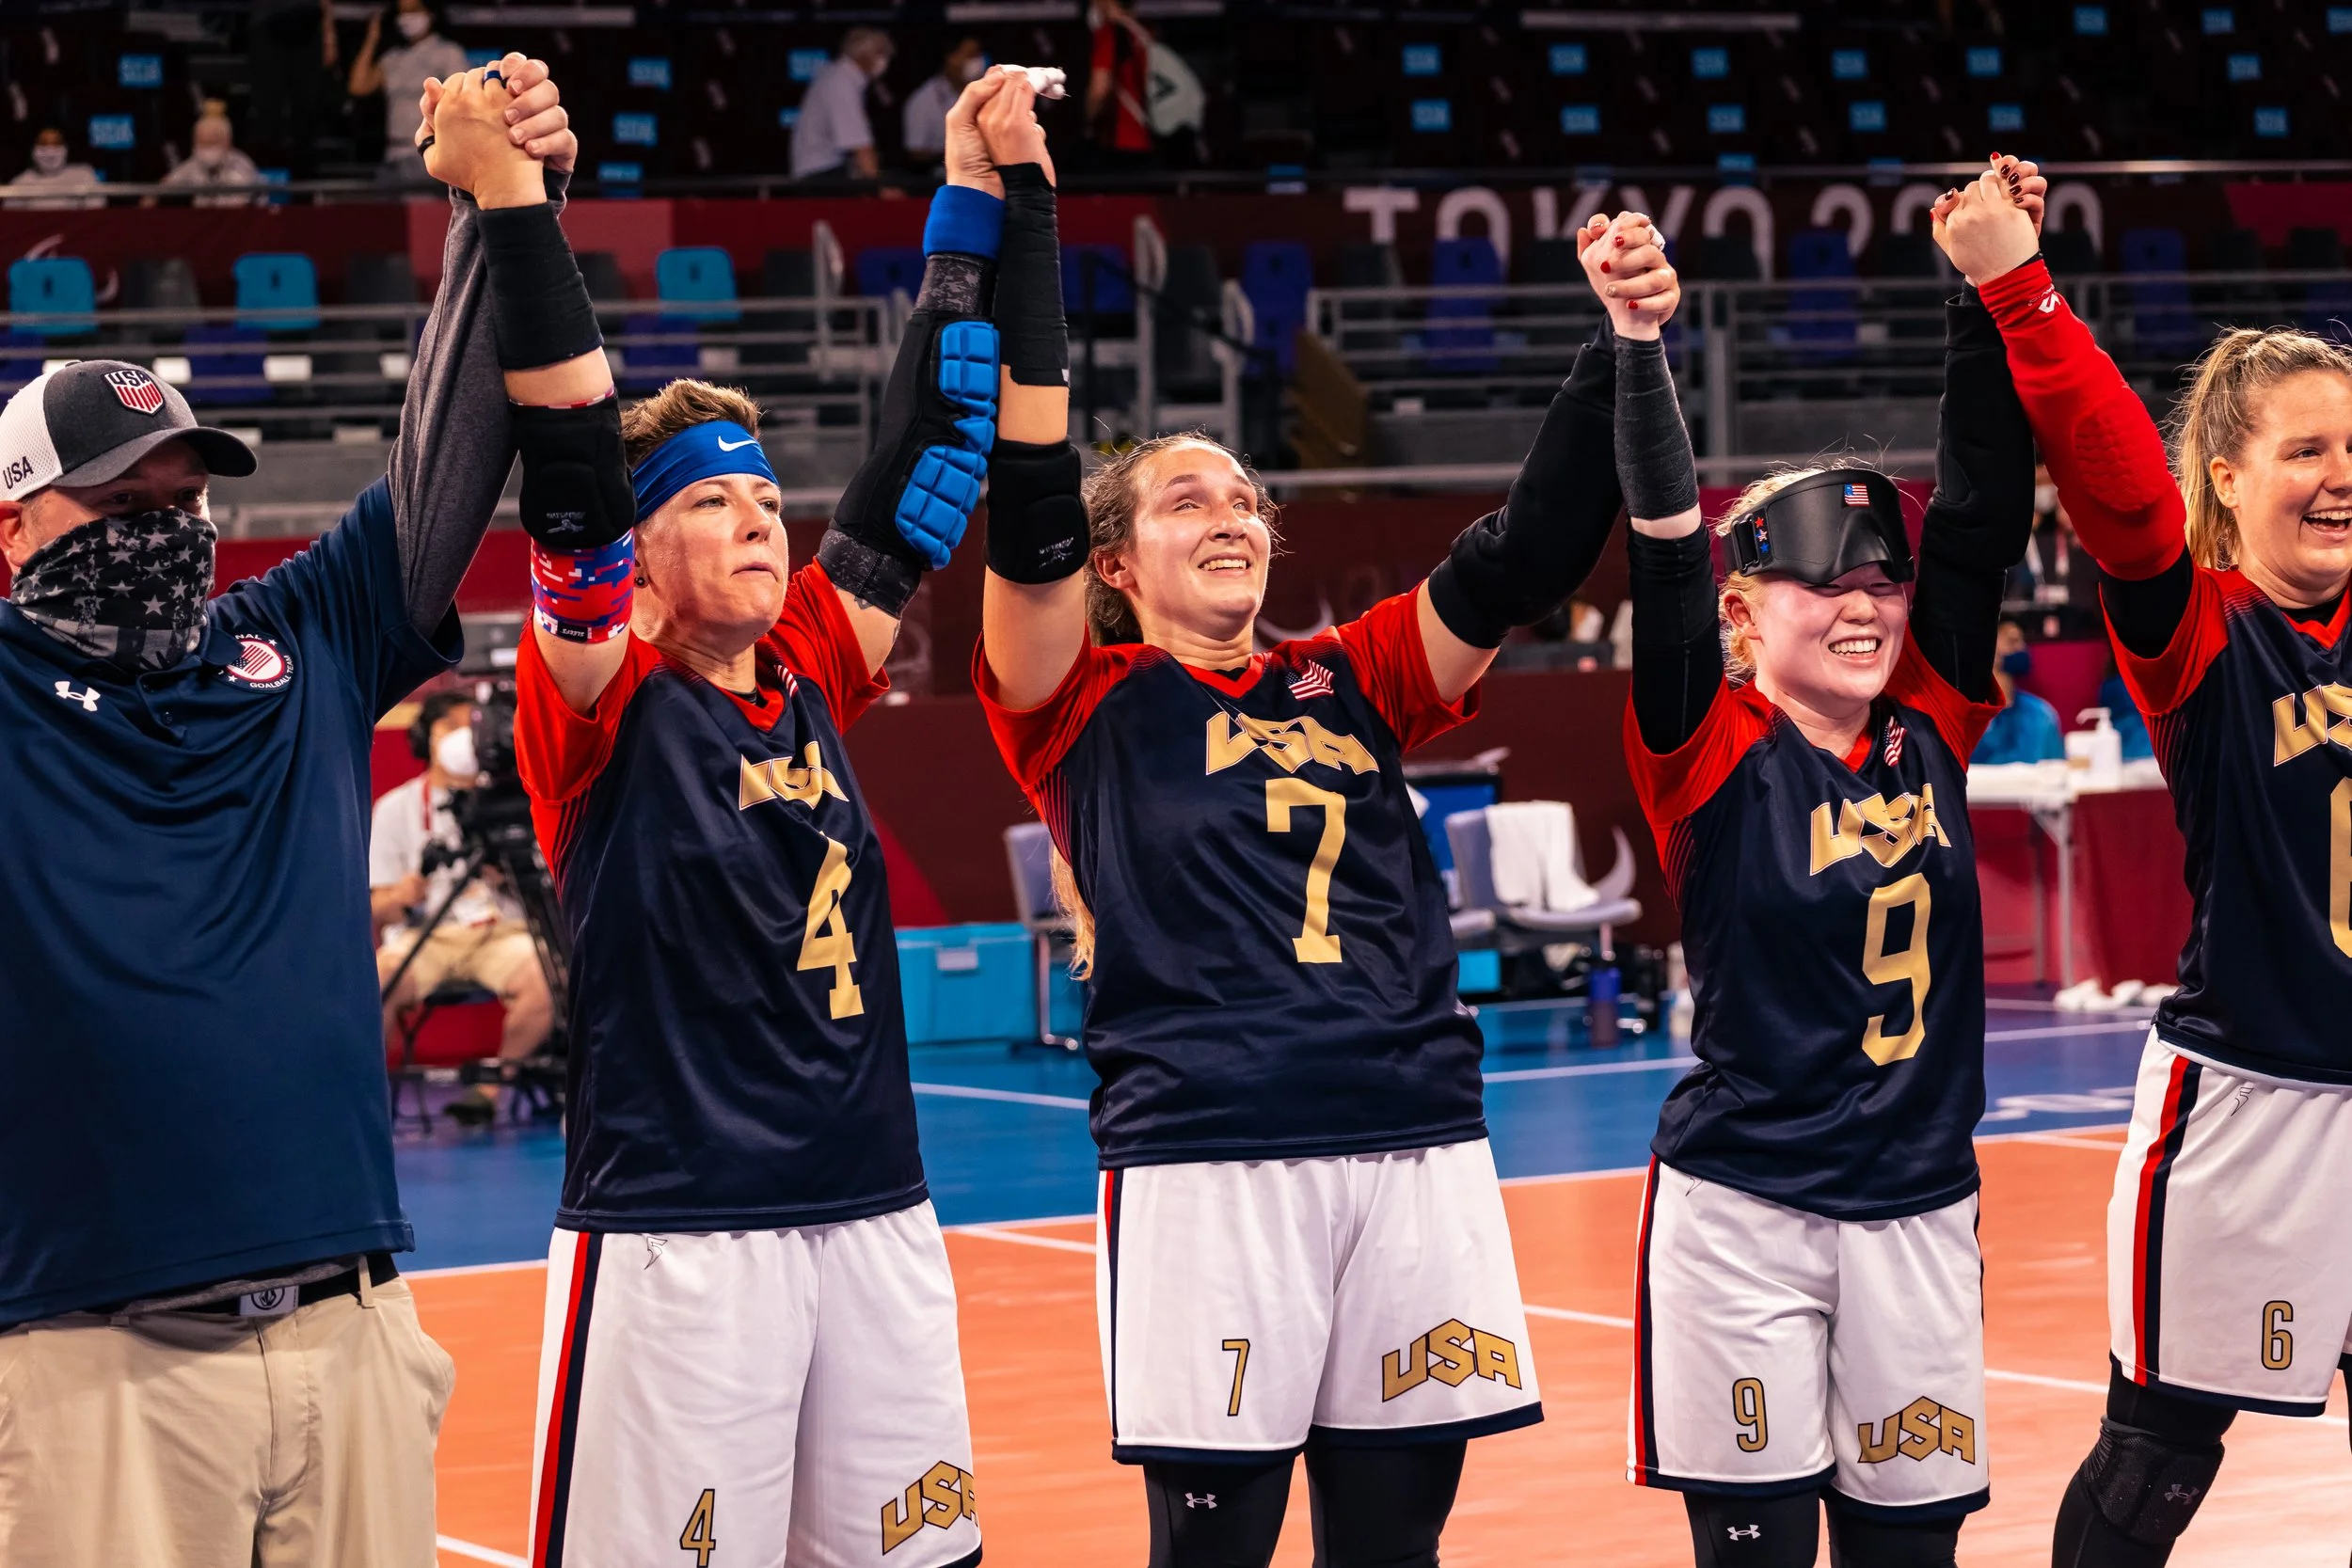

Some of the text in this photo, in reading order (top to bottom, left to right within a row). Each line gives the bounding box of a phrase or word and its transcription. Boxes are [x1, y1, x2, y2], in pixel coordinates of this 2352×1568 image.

[1343, 186, 2104, 282] TOKYO 200
[107, 371, 151, 387] USA
[3, 456, 35, 489] USA
[249, 655, 294, 689] GOALBALL TEAM
[1206, 711, 1380, 776] USA
[1809, 783, 1952, 876] USA
[1264, 777, 1346, 964] 7
[796, 831, 865, 1020] 4
[1861, 872, 1931, 1067] 9
[1381, 1318, 1522, 1402] USA
[2260, 1299, 2295, 1370] 6
[1222, 1338, 1250, 1417] 7
[1731, 1377, 1770, 1452] 9
[1857, 1396, 1977, 1465] USA
[679, 1488, 716, 1568] 4
